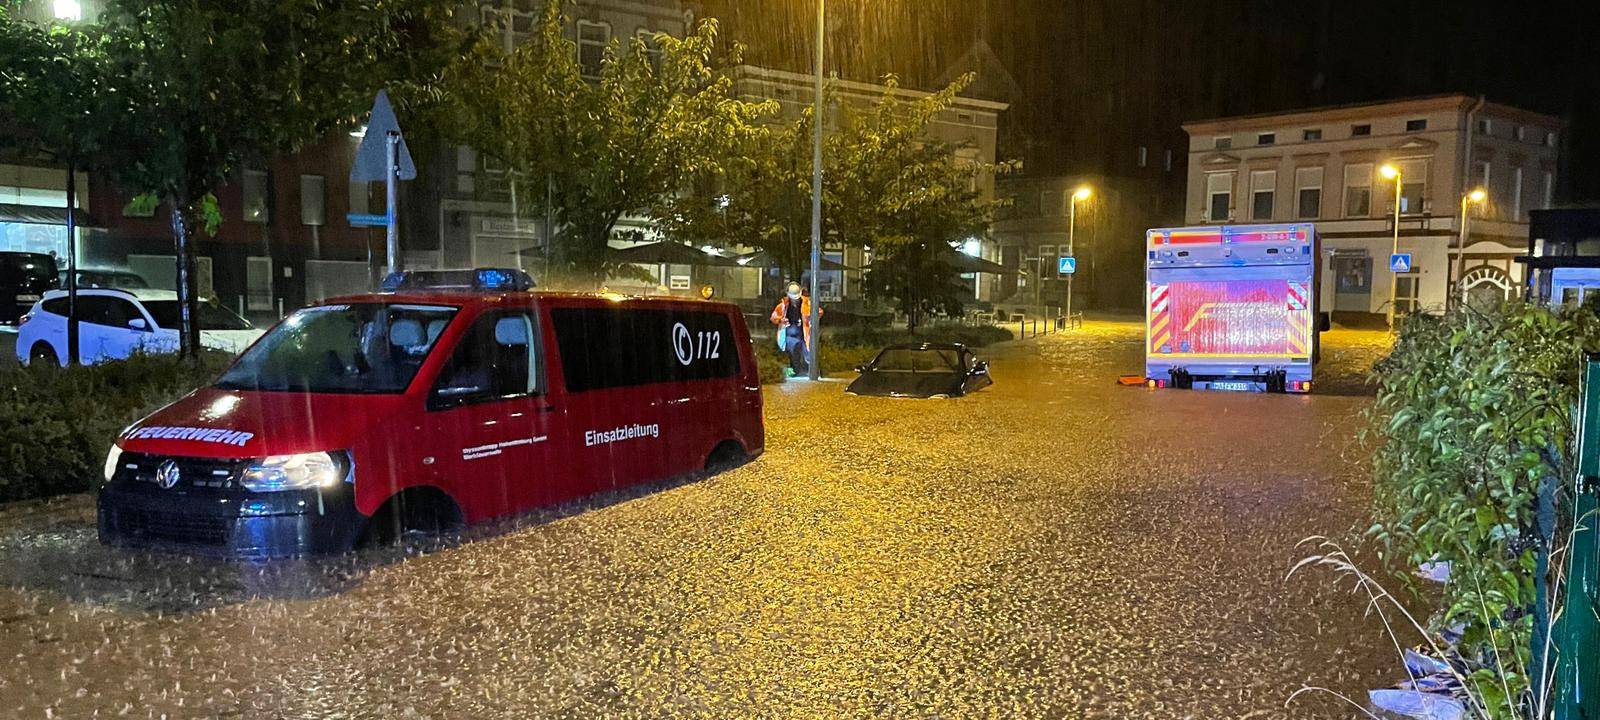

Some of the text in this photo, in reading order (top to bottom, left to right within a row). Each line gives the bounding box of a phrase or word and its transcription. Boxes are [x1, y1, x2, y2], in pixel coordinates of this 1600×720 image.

[697, 331, 720, 359] 112
[131, 426, 254, 447] FEUERWEHR
[585, 423, 659, 446] Einsatzleitung
